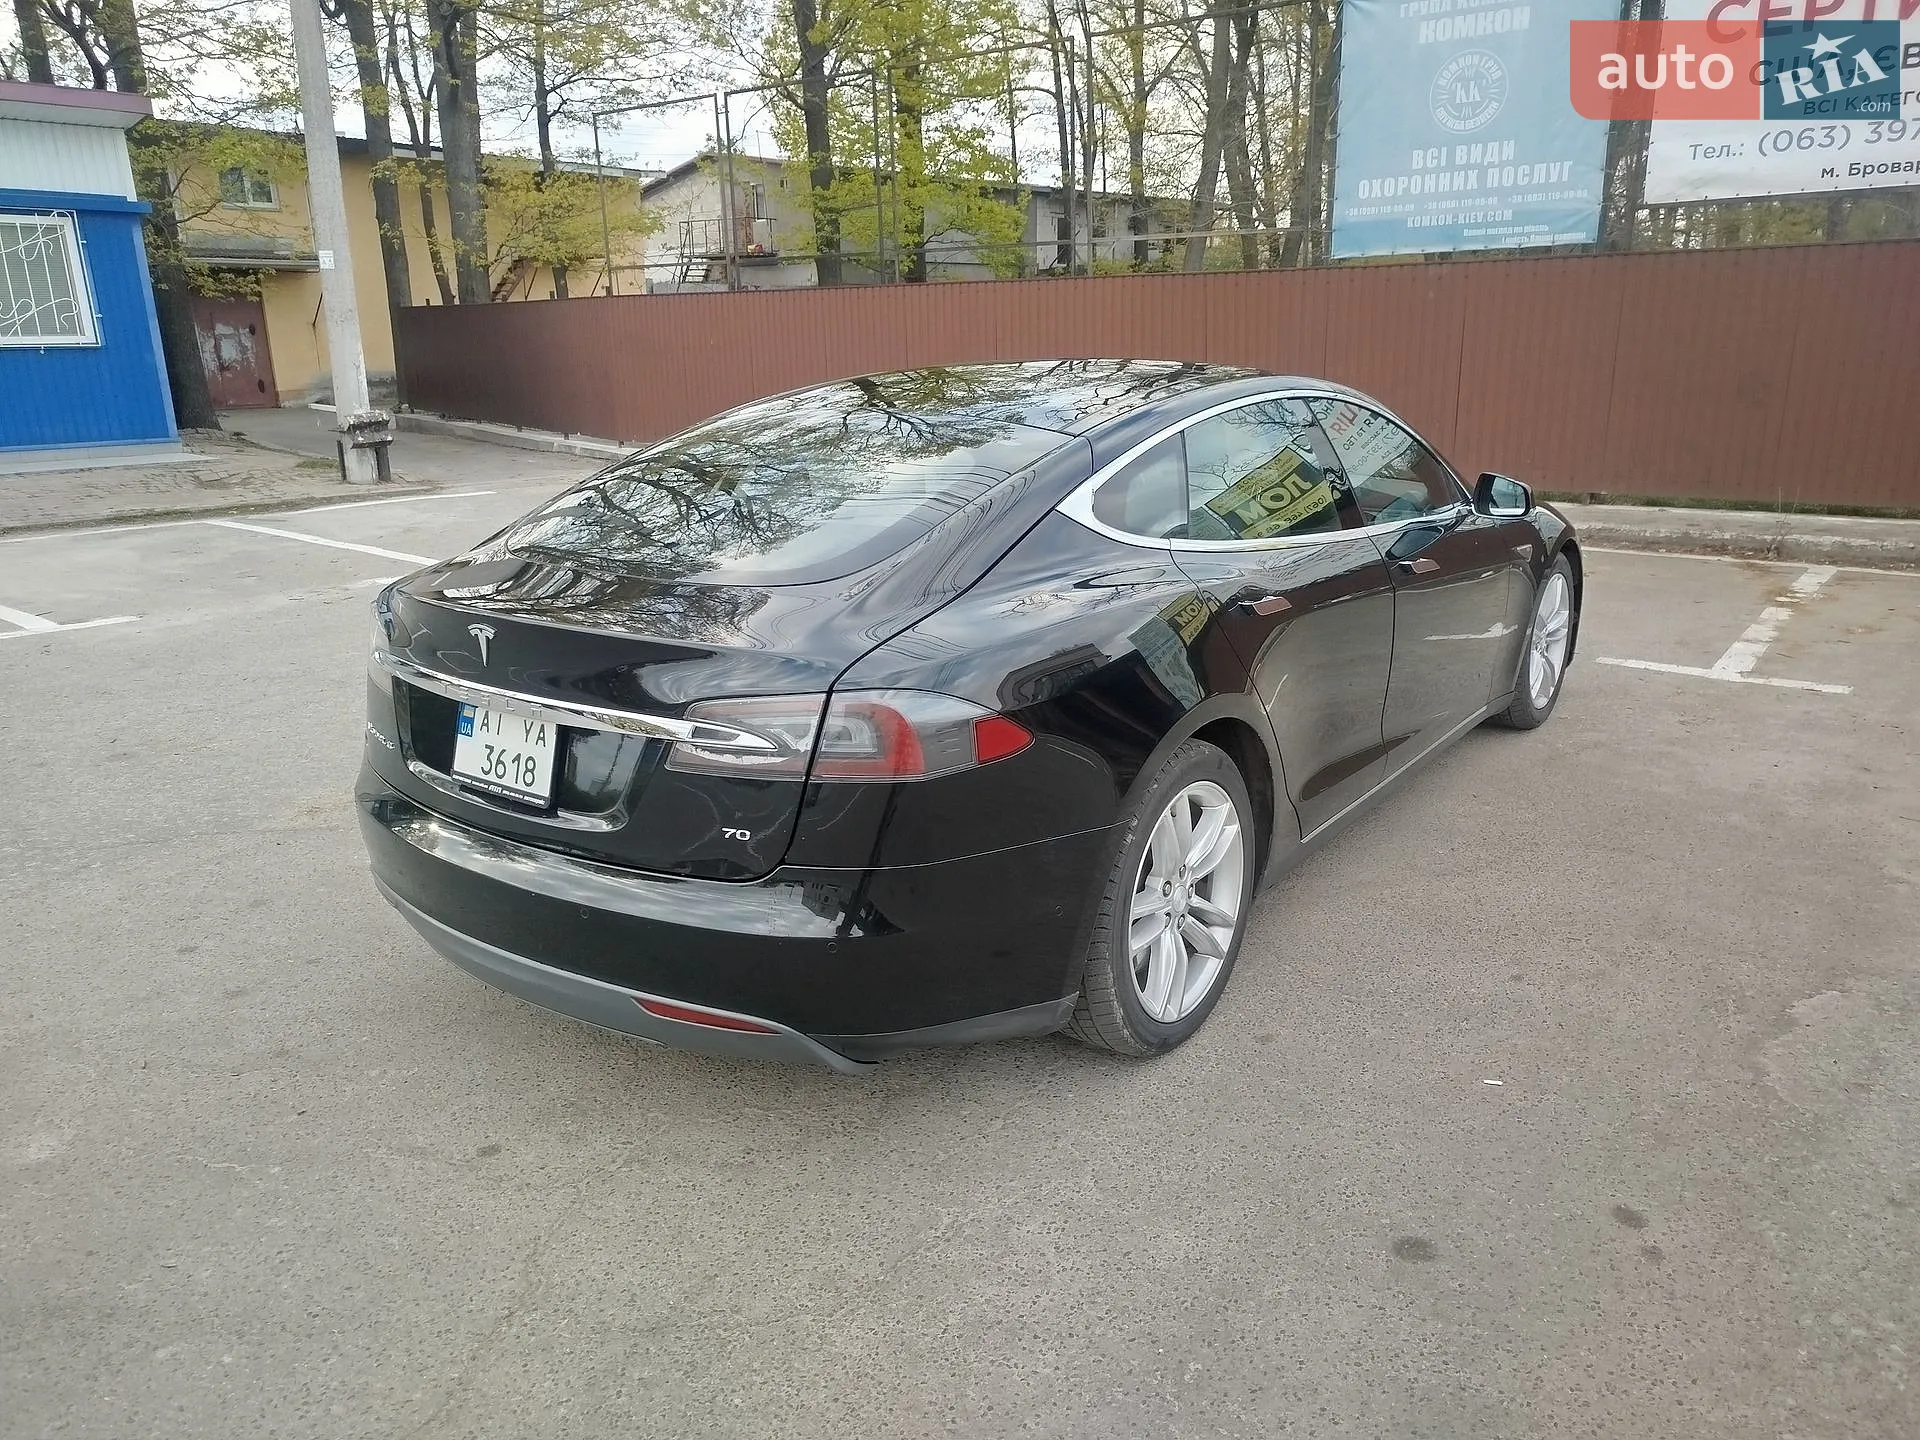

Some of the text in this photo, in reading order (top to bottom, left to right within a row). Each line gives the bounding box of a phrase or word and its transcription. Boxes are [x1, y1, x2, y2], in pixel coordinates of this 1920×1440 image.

[1418, 6, 1531, 43] КОМКОН
[1803, 99, 1838, 115] ВСІ
[1412, 140, 1515, 170] ВСІ ВИДИ
[1689, 142, 1746, 161] Тел.:
[1758, 124, 1851, 157] (063)
[1358, 160, 1573, 200] ОХОРОННИХ ПОСЛУГ
[1821, 166, 1840, 179] м.
[461, 721, 473, 735] UA
[523, 719, 547, 748] YA
[480, 743, 537, 788] 3618
[721, 827, 751, 841] 70
